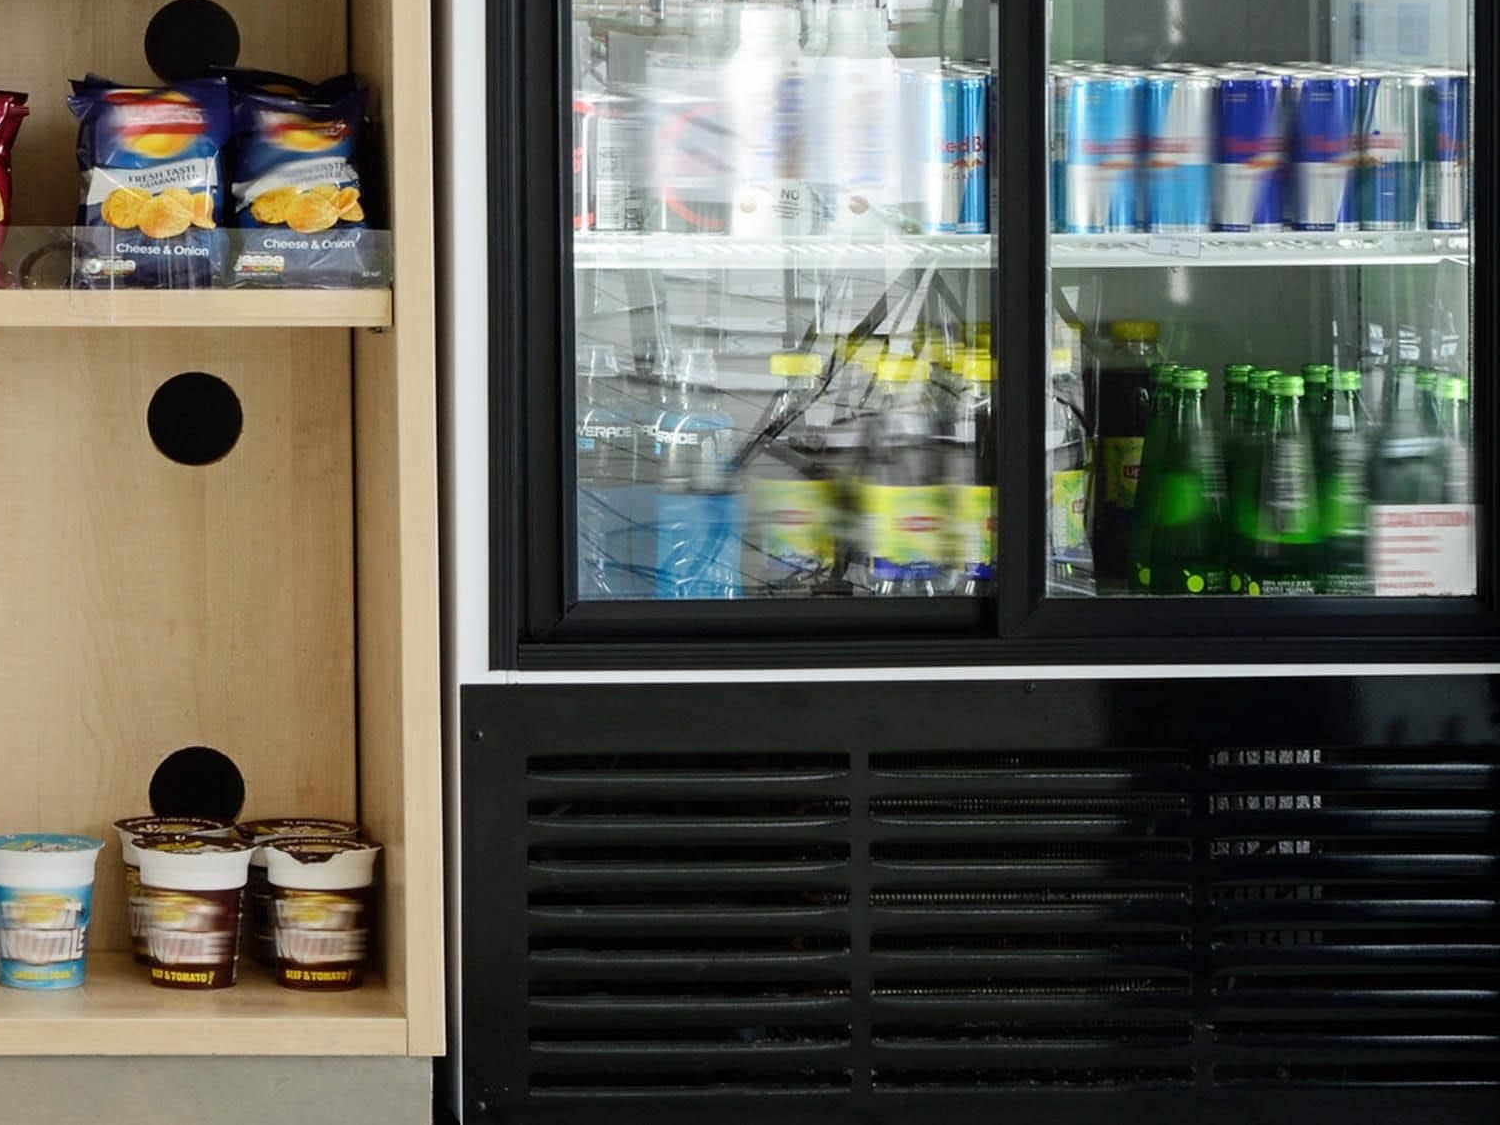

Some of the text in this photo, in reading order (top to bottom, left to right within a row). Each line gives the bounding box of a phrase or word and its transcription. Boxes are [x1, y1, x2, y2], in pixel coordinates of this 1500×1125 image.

[116, 243, 209, 256] Cheese & Onion
[263, 238, 356, 250] Cheese & Onion
[170, 971, 208, 984] TOMATO
[311, 970, 348, 982] TOMATO
